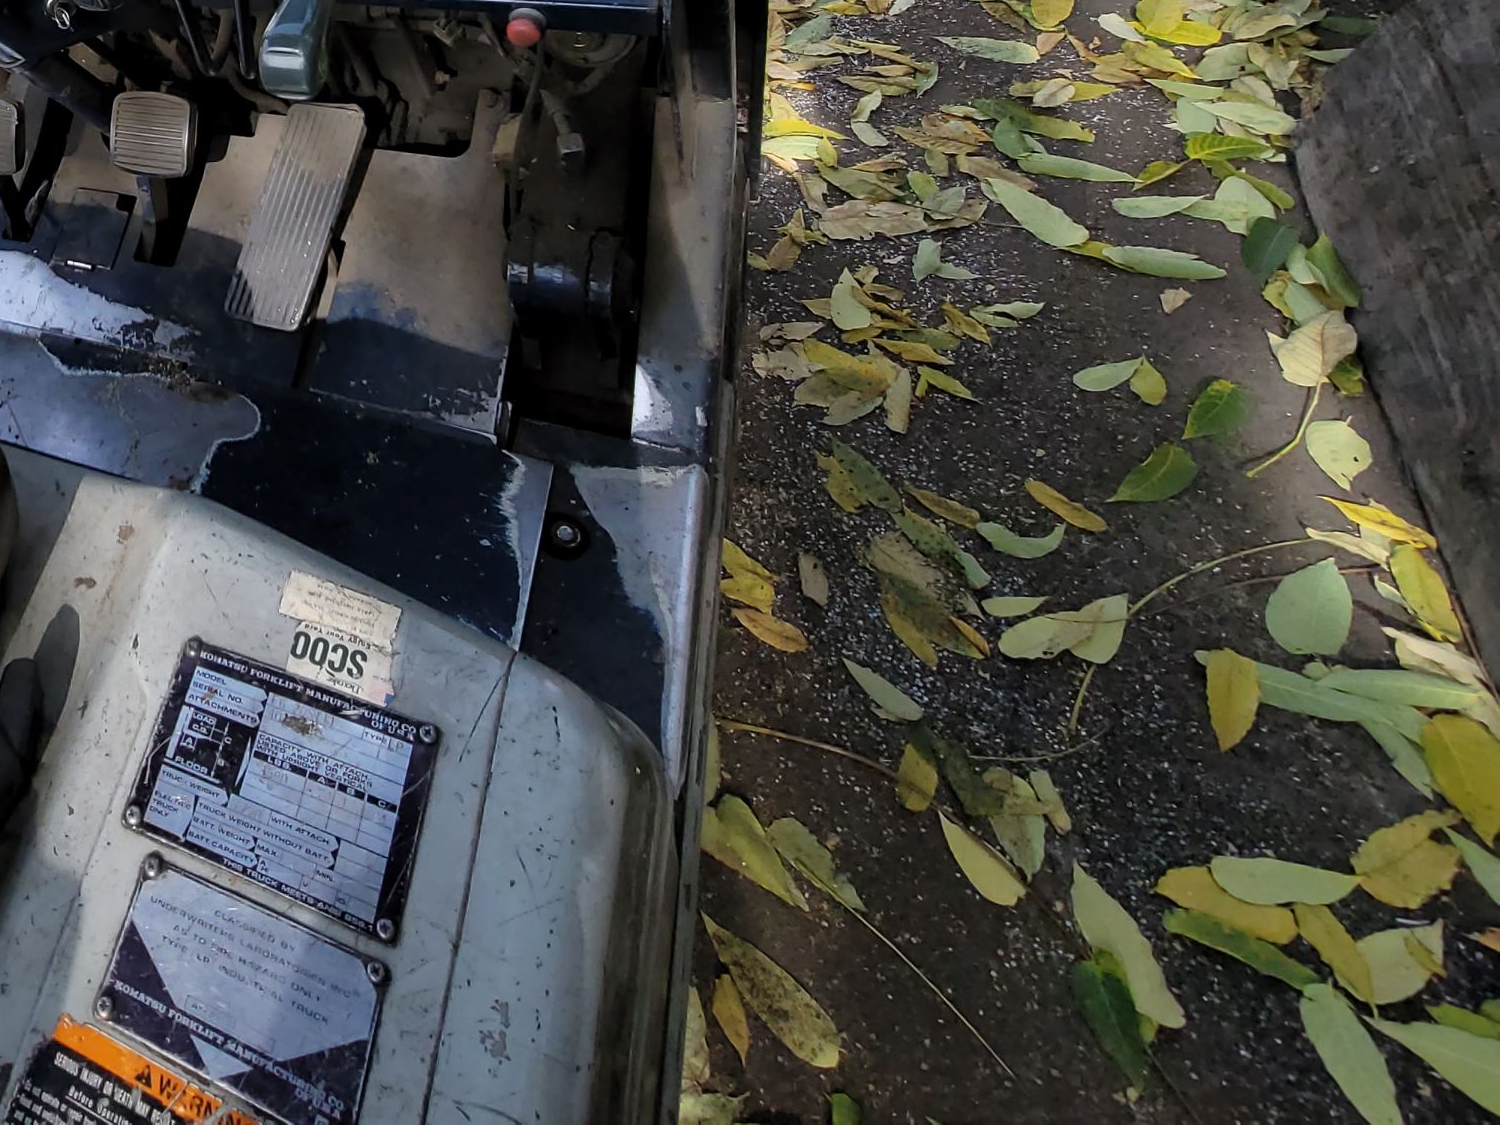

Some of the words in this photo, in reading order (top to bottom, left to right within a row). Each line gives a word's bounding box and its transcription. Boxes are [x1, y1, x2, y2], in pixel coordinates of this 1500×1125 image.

[304, 623, 323, 635] Yard
[326, 631, 345, 642] Your
[196, 670, 227, 686] MODEL
[200, 650, 248, 674] KOMATSU
[249, 667, 304, 693] FORKLIFT
[192, 680, 224, 697] SERIAL
[193, 711, 216, 725] LOAD
[185, 736, 193, 745] A
[224, 736, 232, 744] C
[364, 731, 389, 745] TYPE
[256, 744, 279, 757] WITH
[257, 739, 287, 755] LISTED
[290, 750, 321, 767] ABOVE
[259, 734, 302, 754] CAPACITY
[306, 750, 329, 765] WITH
[174, 755, 209, 774] FLOOR
[316, 775, 326, 785] A
[189, 781, 221, 799] WEIGHT
[148, 805, 170, 818] ONLY
[152, 798, 180, 813] TRUCK
[377, 799, 388, 808] C
[199, 802, 227, 820] TRUCK
[227, 815, 262, 834] WEIGHT
[262, 826, 303, 851] WITHOUT
[271, 816, 293, 830] WITH
[217, 826, 251, 846] WEIGHT
[211, 840, 255, 864] CAPACITY
[222, 857, 244, 873] THIS
[246, 868, 279, 889] TRUCK
[281, 883, 316, 905] MEETS
[150, 895, 236, 942] UNDERWRITERS
[214, 909, 276, 944] CLASSIFIED
[172, 924, 189, 937] AS
[194, 933, 207, 946] TO
[114, 979, 168, 1014] KOMATSU
[167, 1007, 225, 1045] FORKLIFT
[291, 1000, 330, 1025] TRUCK
[54, 1051, 80, 1077] SERIOUS
[79, 1066, 104, 1089] INJURY
[103, 1080, 114, 1096] OR
[68, 1084, 94, 1109] Before
